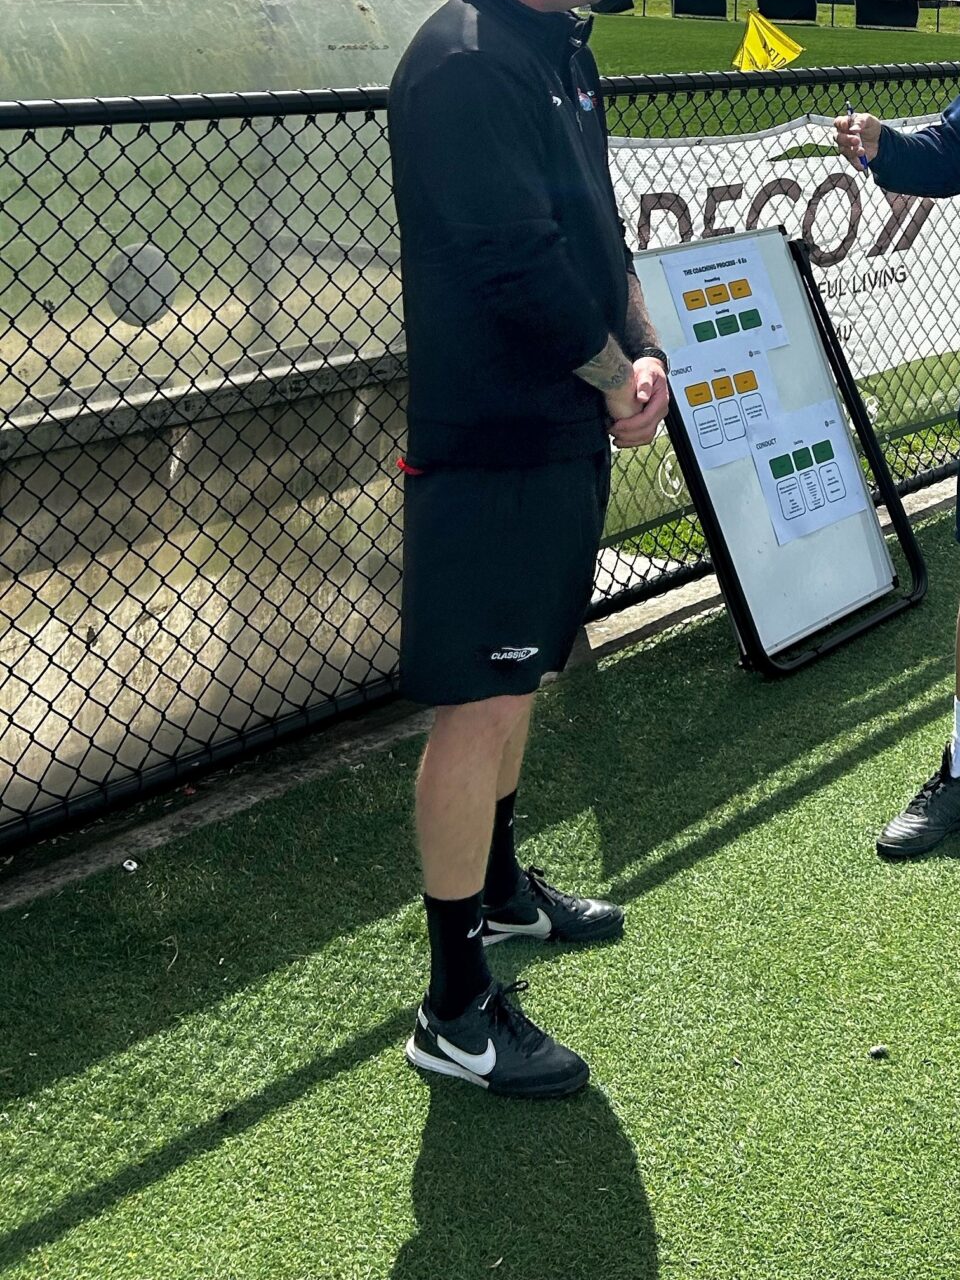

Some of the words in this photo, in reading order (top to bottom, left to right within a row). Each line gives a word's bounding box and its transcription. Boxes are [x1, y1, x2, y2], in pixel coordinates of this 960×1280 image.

[692, 263, 716, 275] COACHING
[716, 259, 736, 269] PROCESS
[852, 265, 907, 294] LIVING
[670, 365, 693, 377] CONDUCT
[756, 437, 776, 450] CONDUCT
[491, 649, 528, 660] CLASSIC
